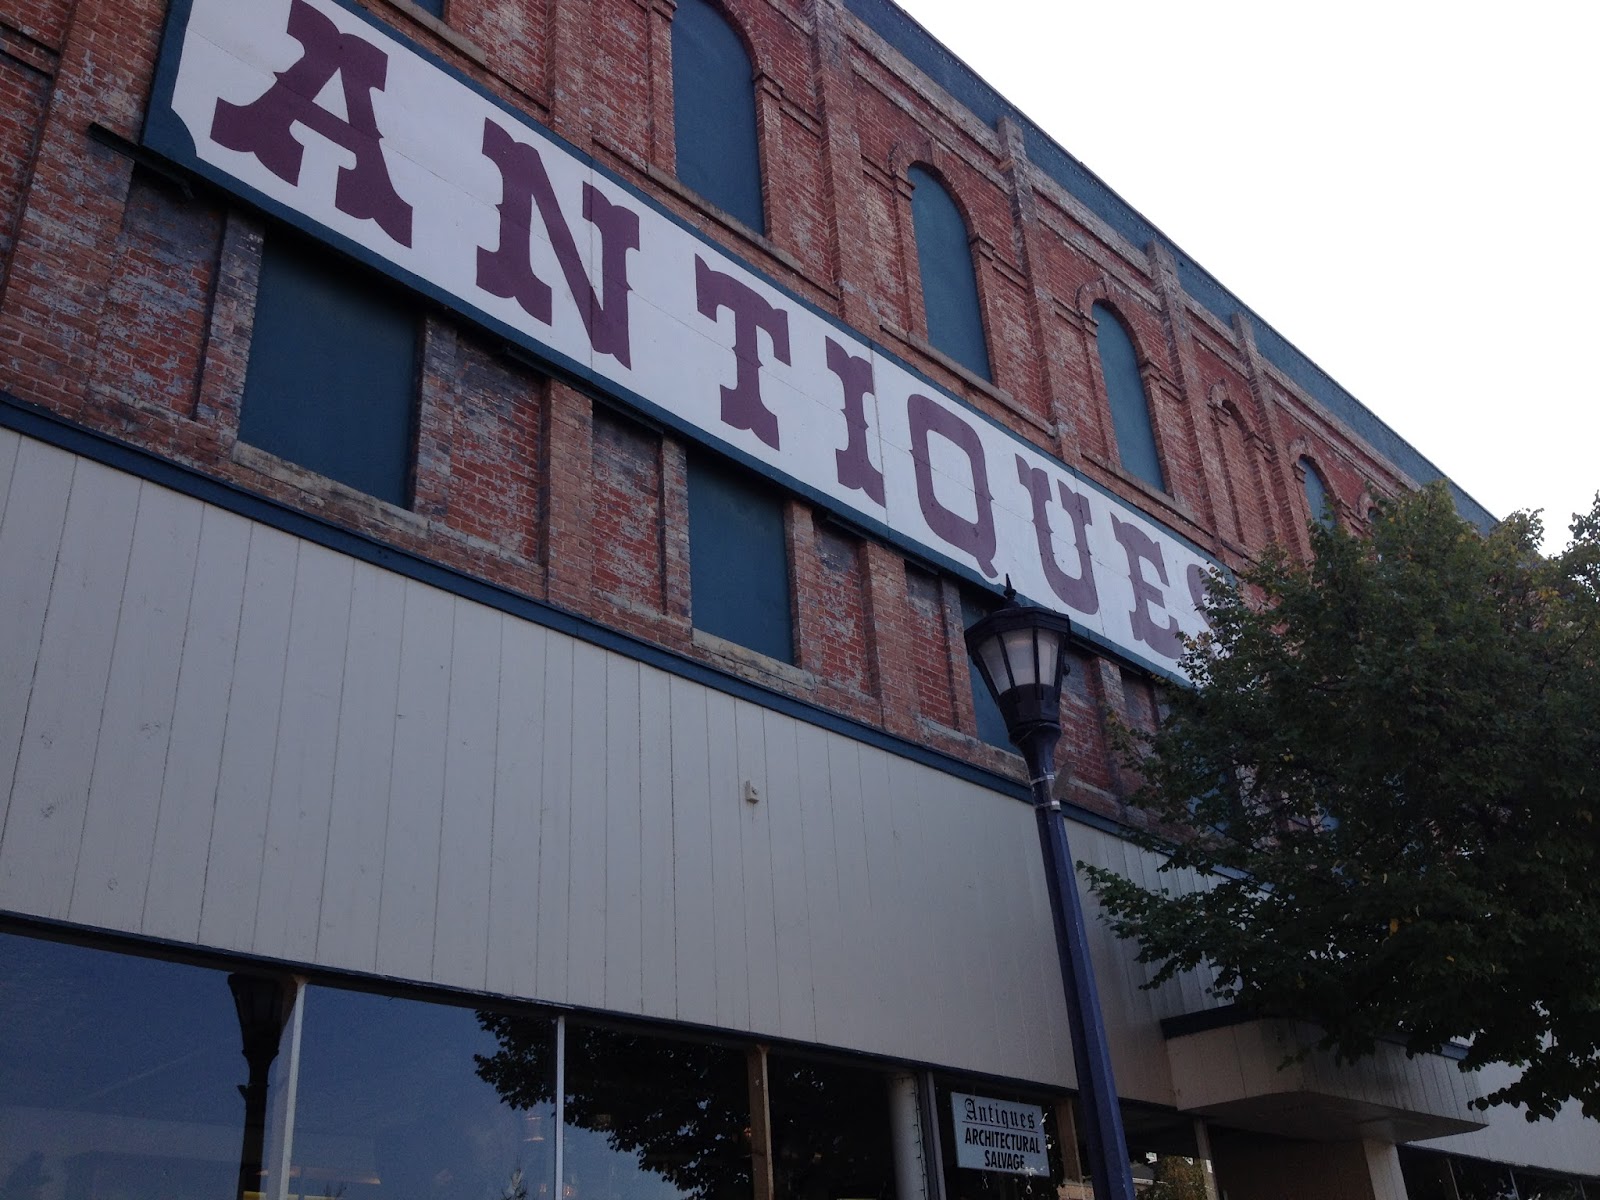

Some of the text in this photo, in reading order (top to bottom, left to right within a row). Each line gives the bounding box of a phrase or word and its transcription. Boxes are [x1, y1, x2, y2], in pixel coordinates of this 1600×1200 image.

[965, 1098, 1035, 1129] Antiques
[965, 1128, 1040, 1154] ARCHITECTURAL
[985, 1150, 1025, 1170] SALVAGE
